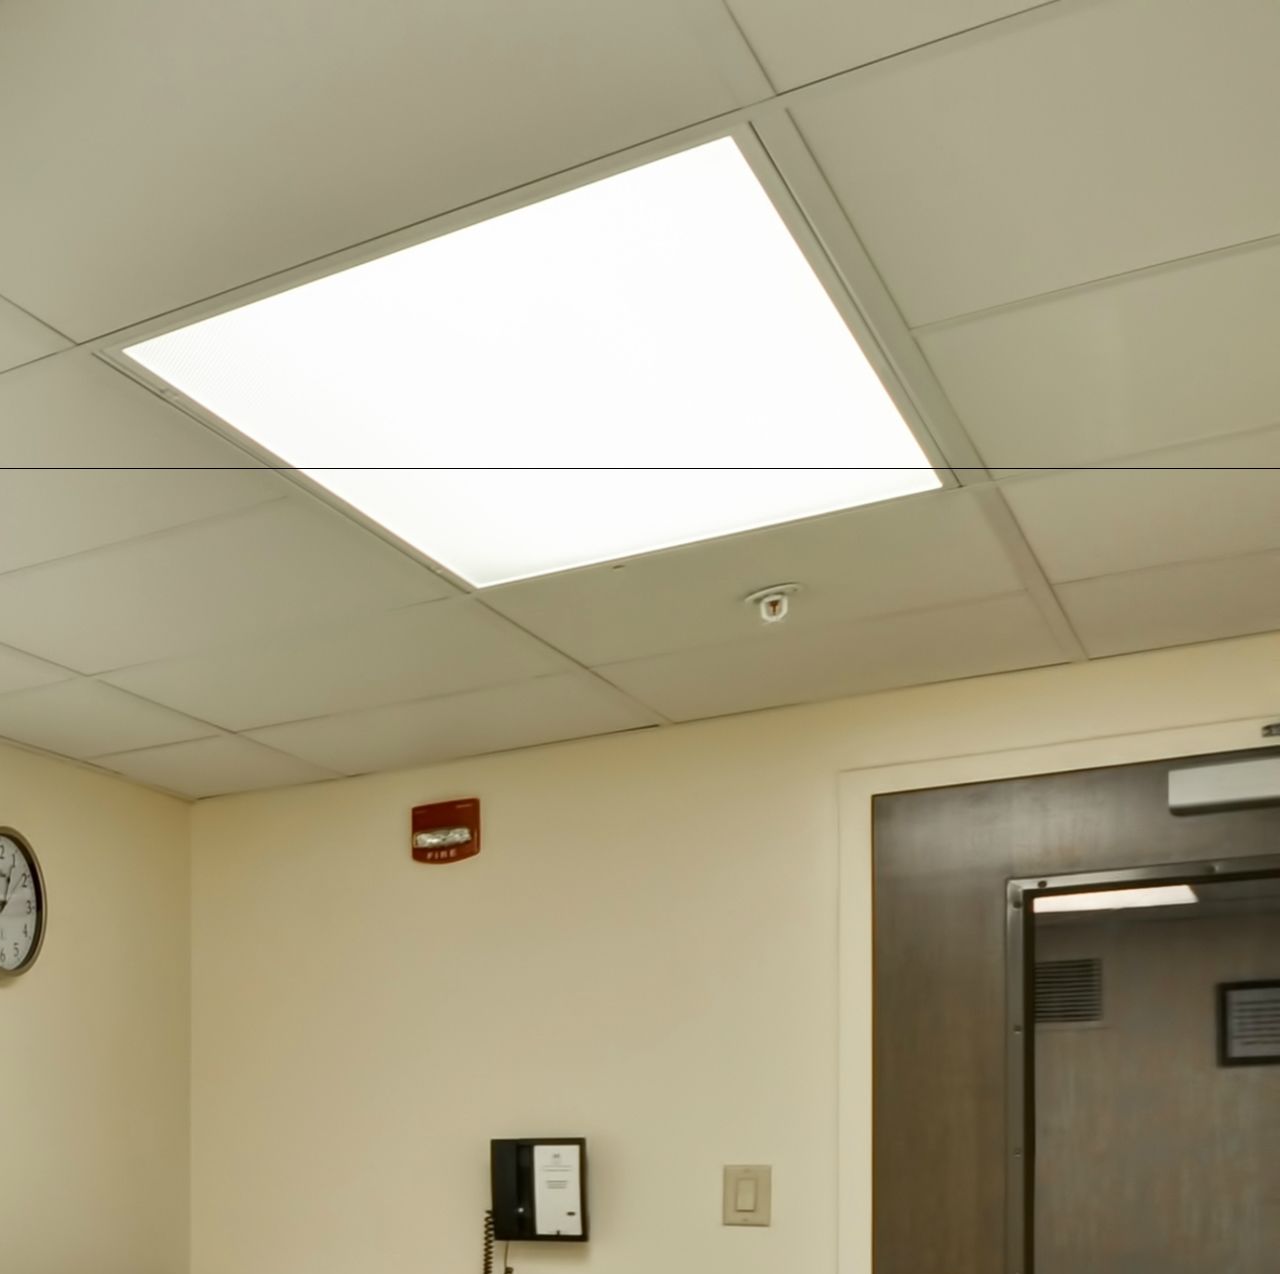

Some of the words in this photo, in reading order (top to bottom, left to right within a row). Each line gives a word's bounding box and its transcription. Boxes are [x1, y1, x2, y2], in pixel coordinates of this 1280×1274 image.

[21, 873, 28, 888] 2
[26, 900, 32, 915] 3
[23, 923, 28, 938] 4
[0, 948, 6, 962] 6
[13, 942, 19, 957] 5
